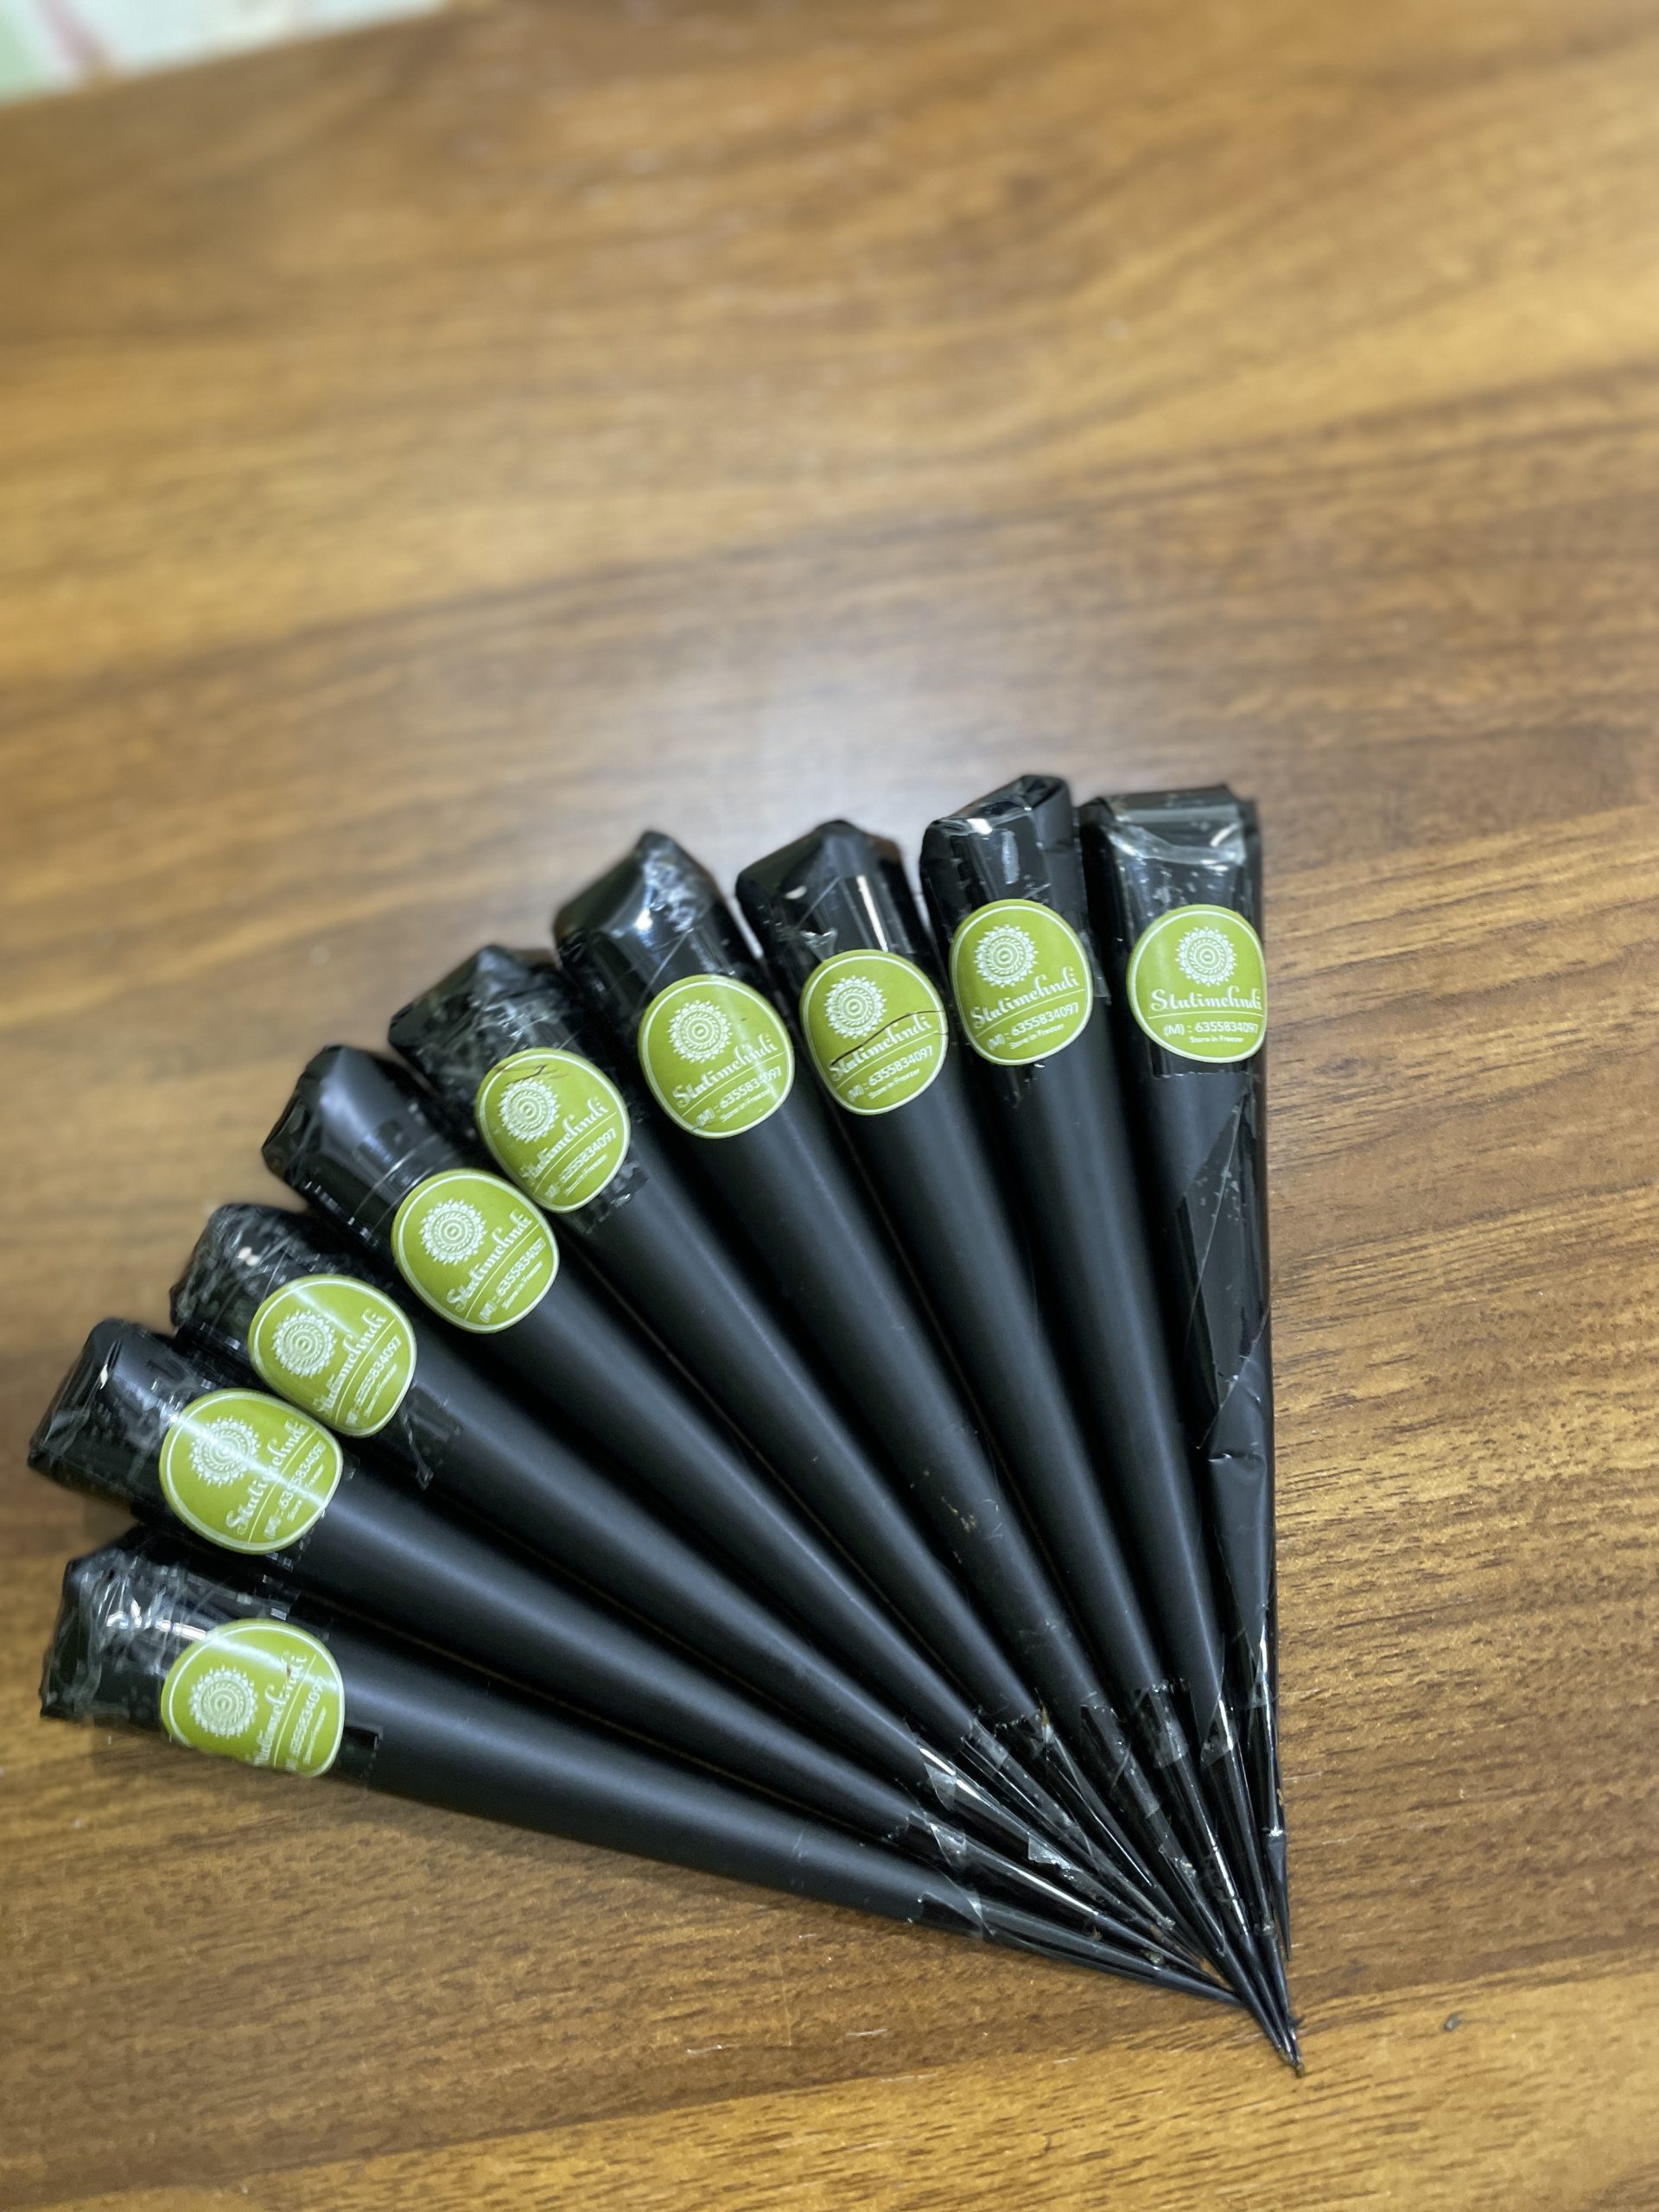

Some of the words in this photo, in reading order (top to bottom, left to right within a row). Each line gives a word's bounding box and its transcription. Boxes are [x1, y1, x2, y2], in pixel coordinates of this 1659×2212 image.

[1011, 1002, 1079, 1036] 6355834097
[1163, 1024, 1185, 1037] (M)
[1195, 1021, 1258, 1033] 6355834097
[868, 1046, 933, 1086] 6355834097
[719, 1065, 781, 1109] 6355834097
[226, 1418, 310, 1535] Stutiehndi
